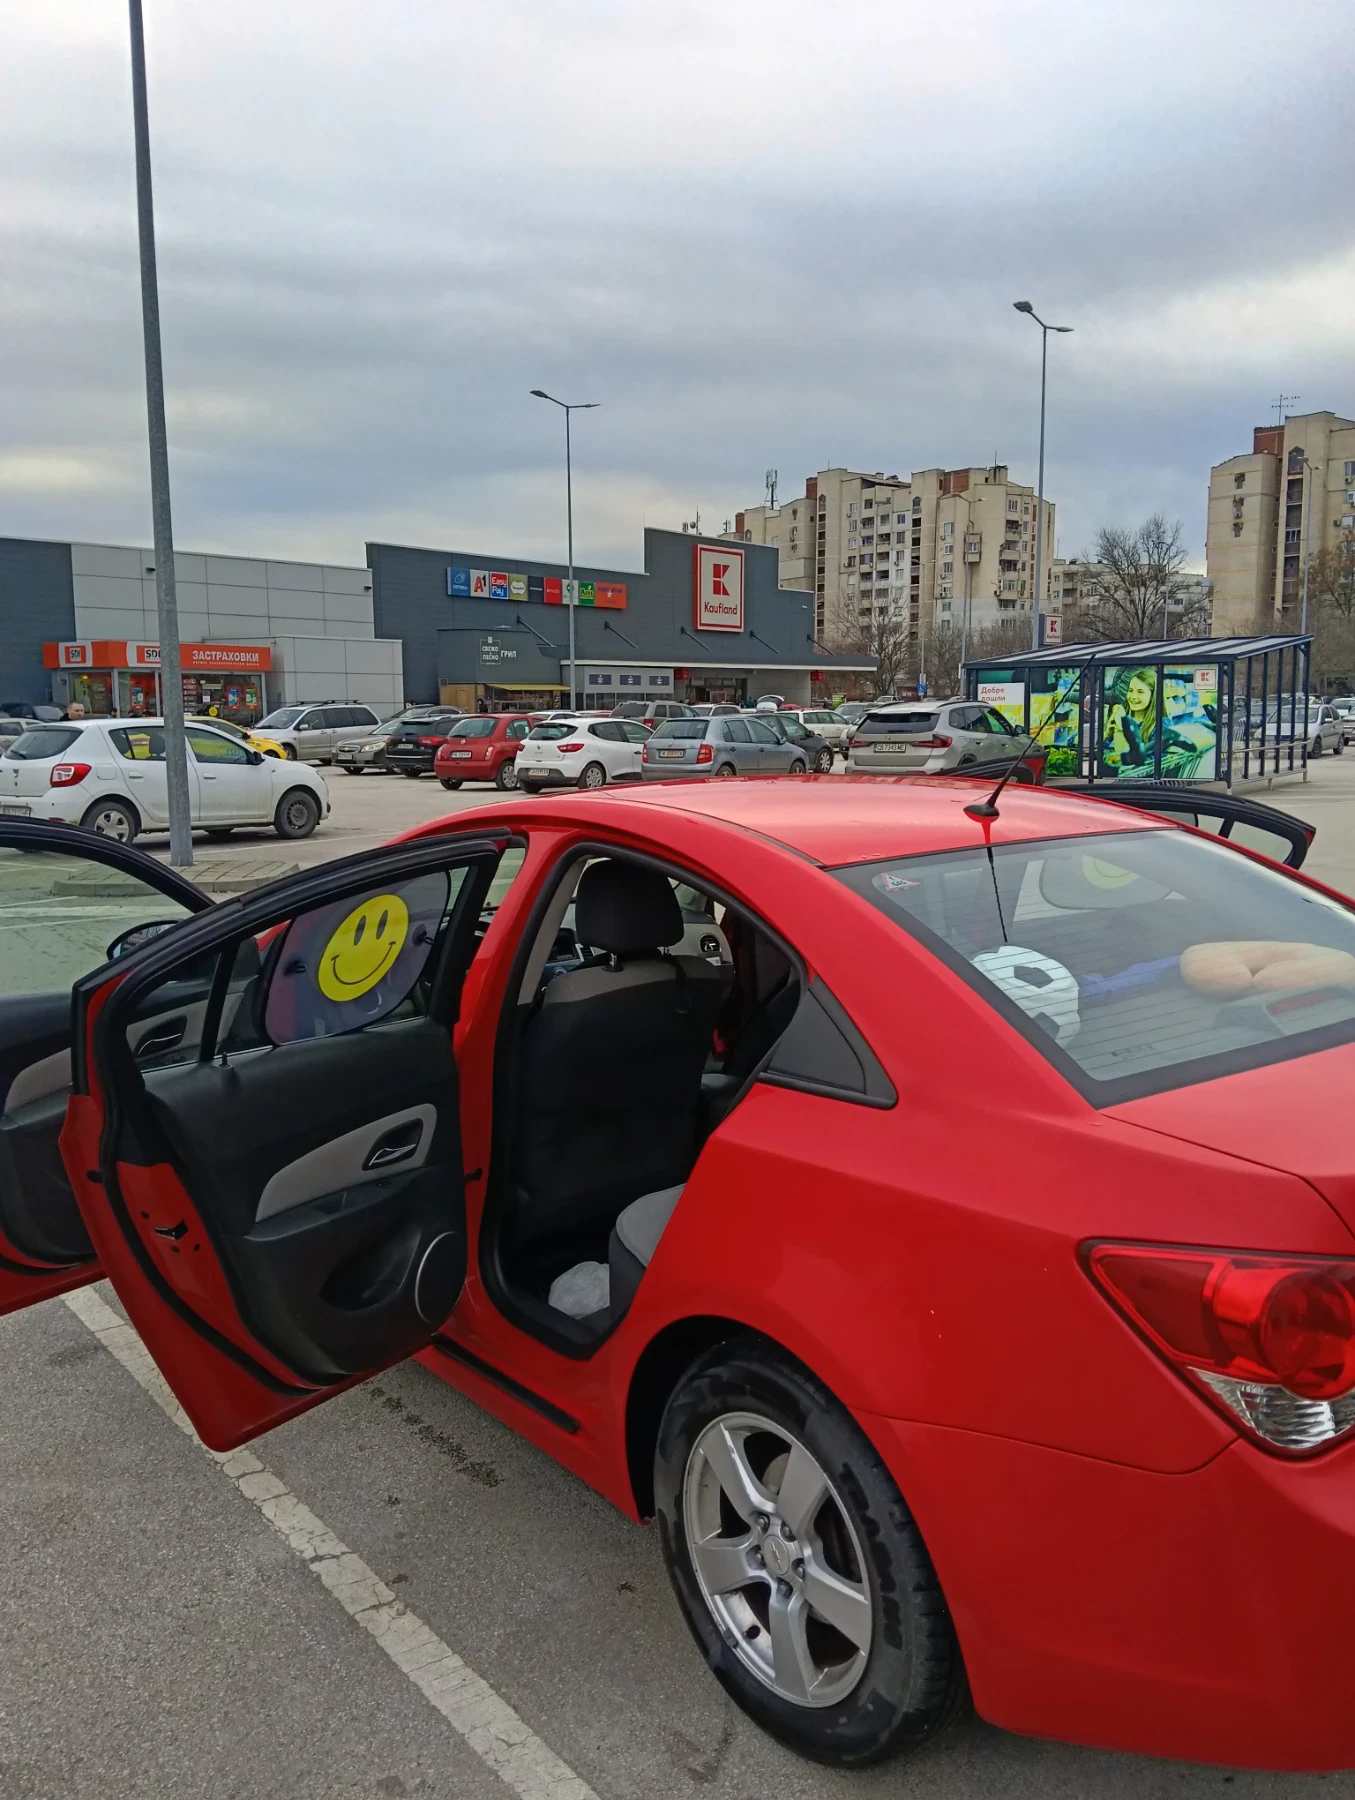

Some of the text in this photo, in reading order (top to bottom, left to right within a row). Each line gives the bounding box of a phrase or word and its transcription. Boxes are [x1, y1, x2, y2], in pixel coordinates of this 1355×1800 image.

[474, 574, 486, 592] A1
[492, 577, 506, 587] Easy
[492, 586, 504, 596] Pay
[704, 601, 738, 615] Kaufland
[145, 649, 160, 658] SDI
[192, 650, 259, 662] ЗАСТРАХОВКИ
[501, 650, 517, 658] ГРИЛ
[981, 686, 1005, 695] Добре
